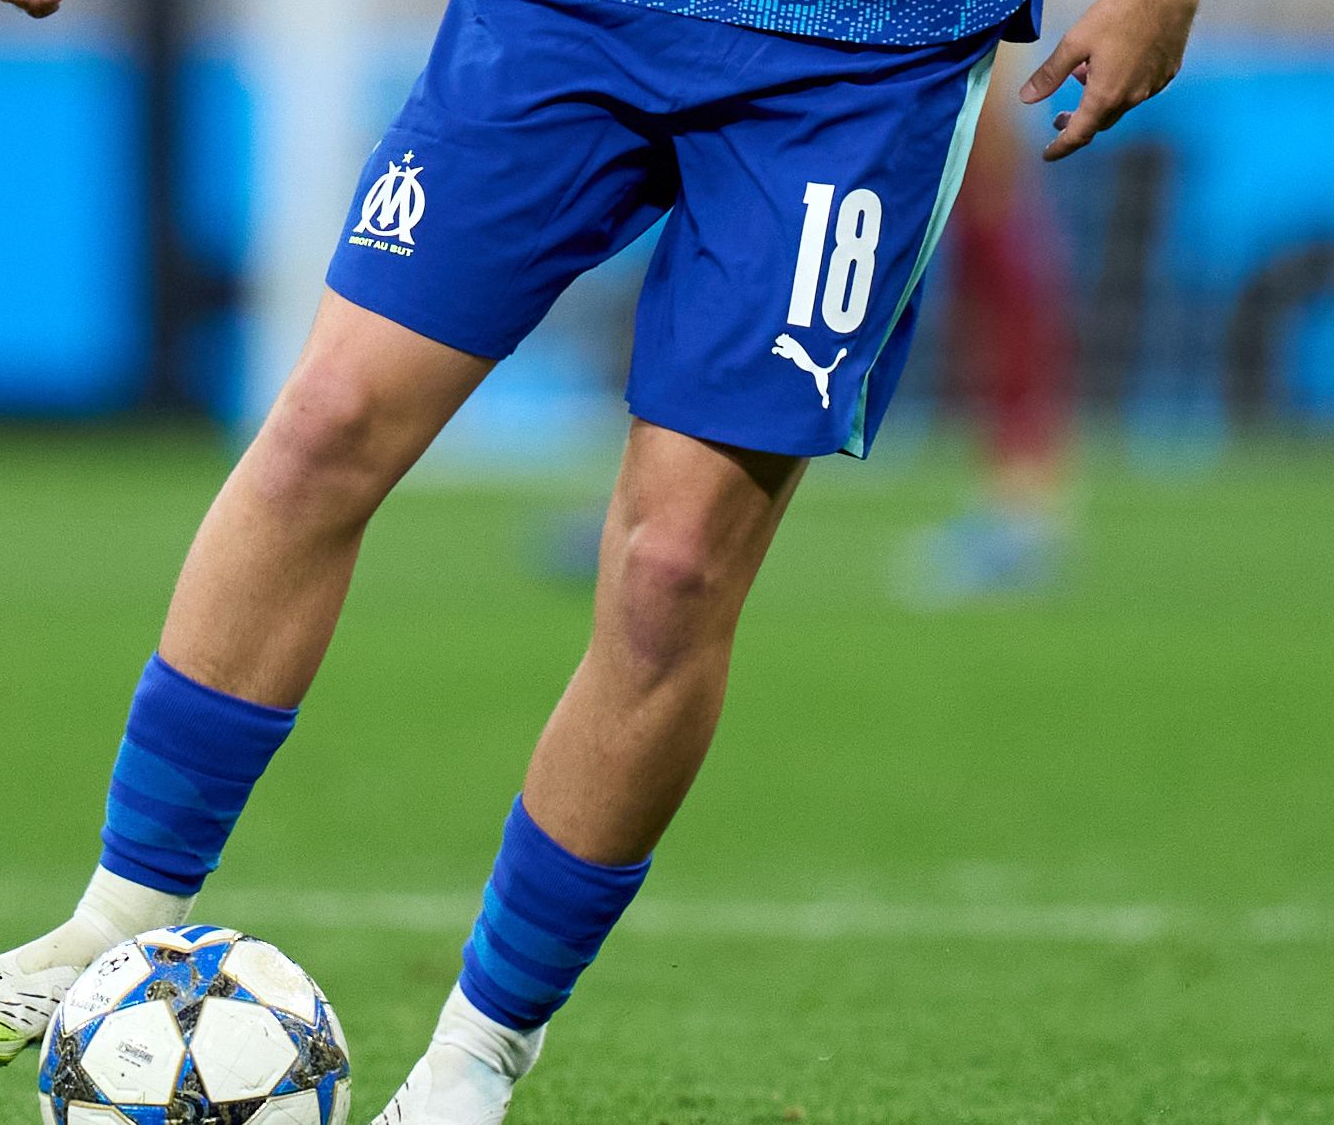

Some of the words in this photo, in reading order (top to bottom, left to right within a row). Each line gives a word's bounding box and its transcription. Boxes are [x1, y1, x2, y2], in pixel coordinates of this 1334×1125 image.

[373, 240, 388, 251] AU
[389, 244, 414, 257] BUT
[786, 181, 883, 334] 18
